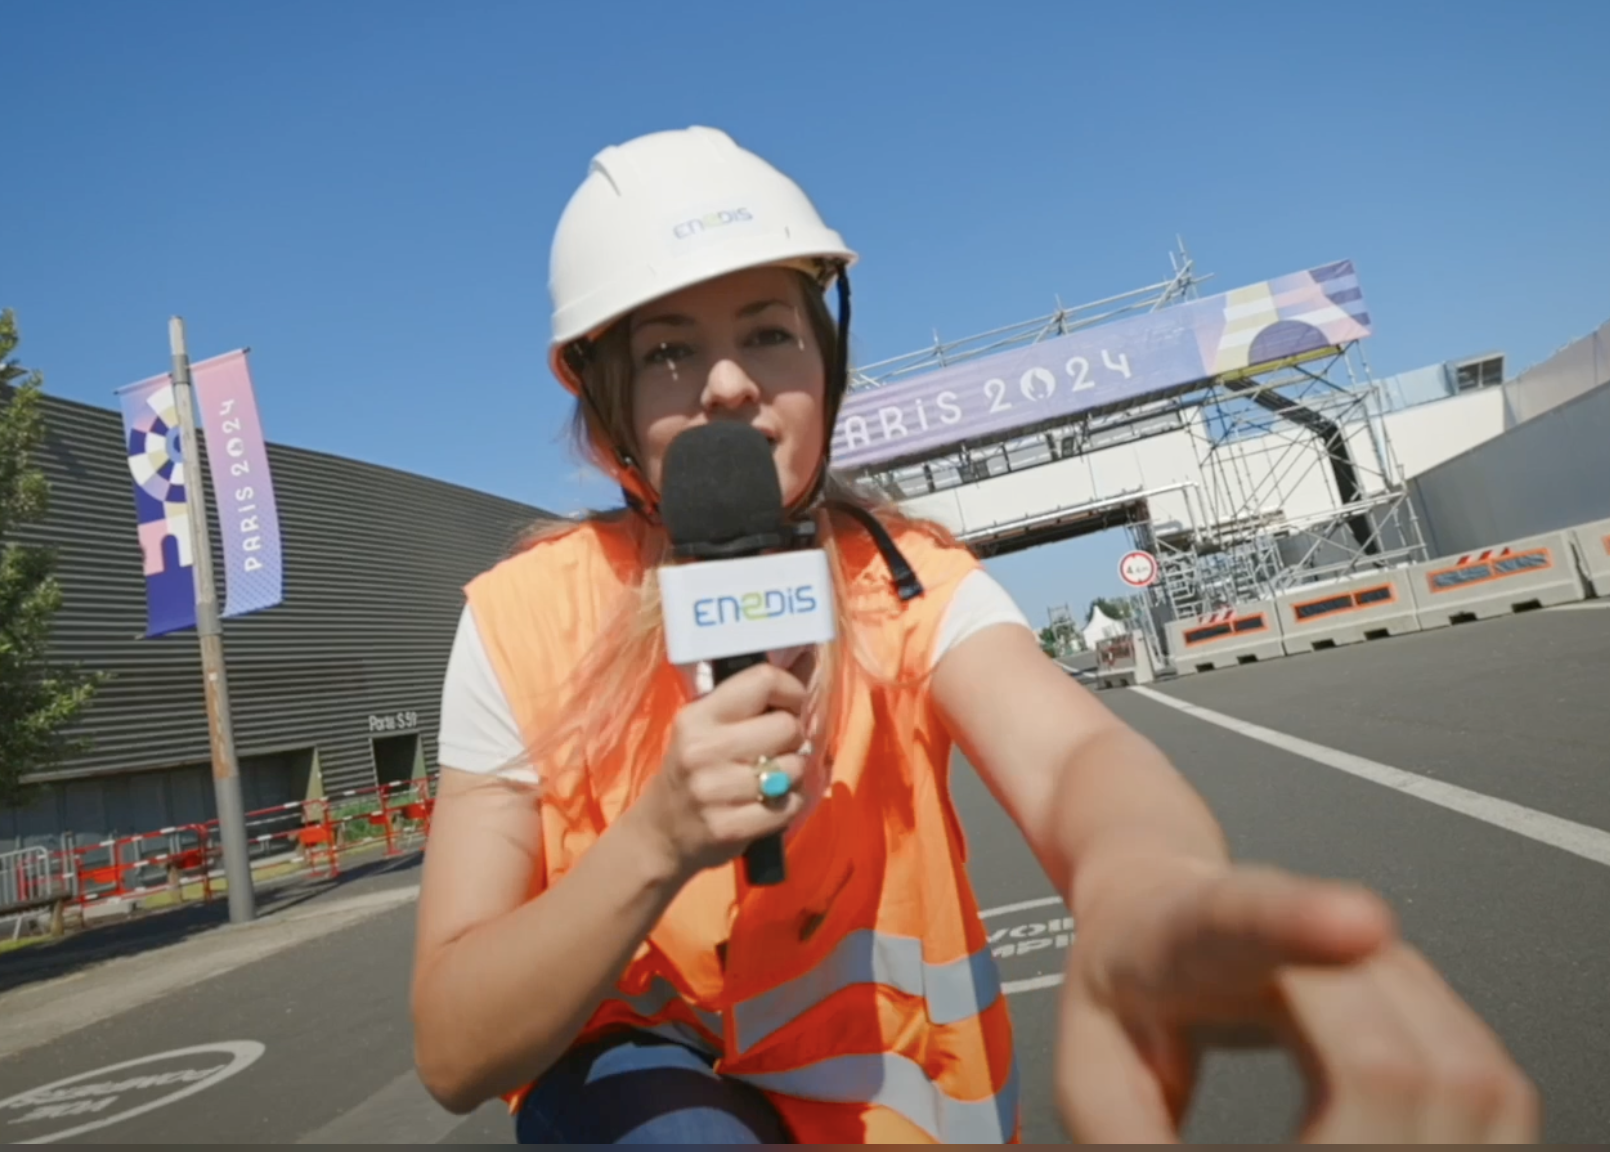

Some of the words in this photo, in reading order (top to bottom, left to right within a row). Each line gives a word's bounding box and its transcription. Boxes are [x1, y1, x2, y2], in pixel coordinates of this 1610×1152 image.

[219, 399, 250, 476] 2024
[844, 390, 962, 450] ARIS
[983, 349, 1132, 414] 2024
[235, 486, 263, 572] PARIS
[694, 585, 816, 627] ENEDIS
